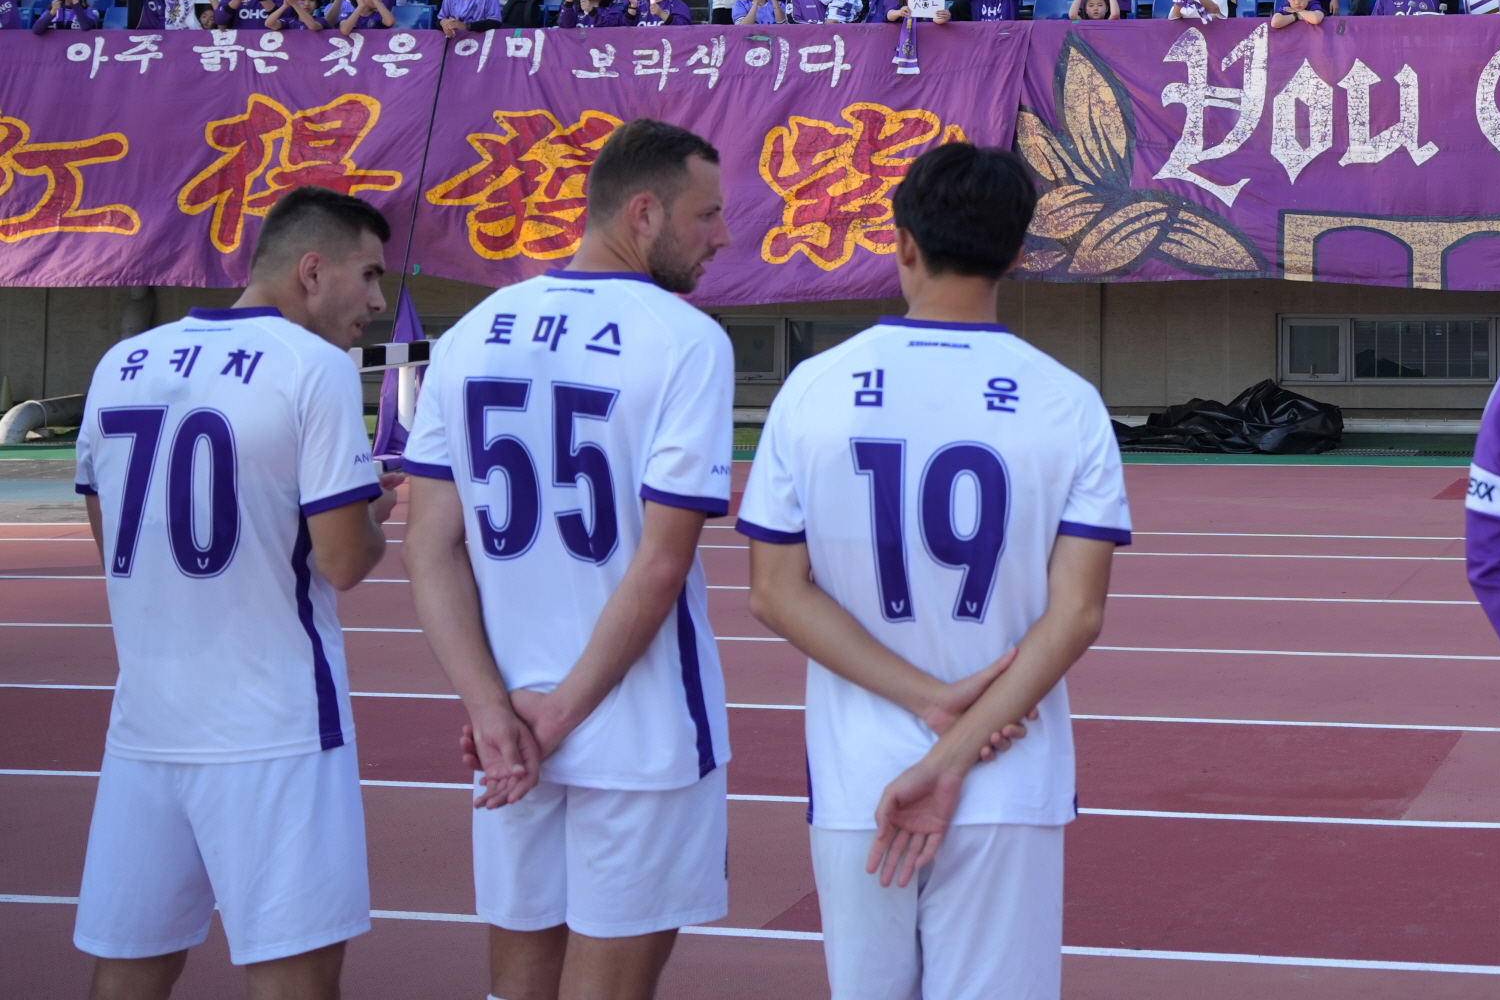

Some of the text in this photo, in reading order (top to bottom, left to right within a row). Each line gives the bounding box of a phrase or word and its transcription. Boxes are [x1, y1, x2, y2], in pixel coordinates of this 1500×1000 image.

[66, 28, 852, 92] 아주 붉은 것은 이미 보라색이다
[239, 8, 269, 20] OHC
[1152, 22, 1440, 208] You
[119, 345, 264, 384] 유키치
[484, 312, 622, 356] 토마스
[97, 405, 240, 579] 70
[462, 376, 620, 568] 55
[849, 437, 1012, 625] 19
